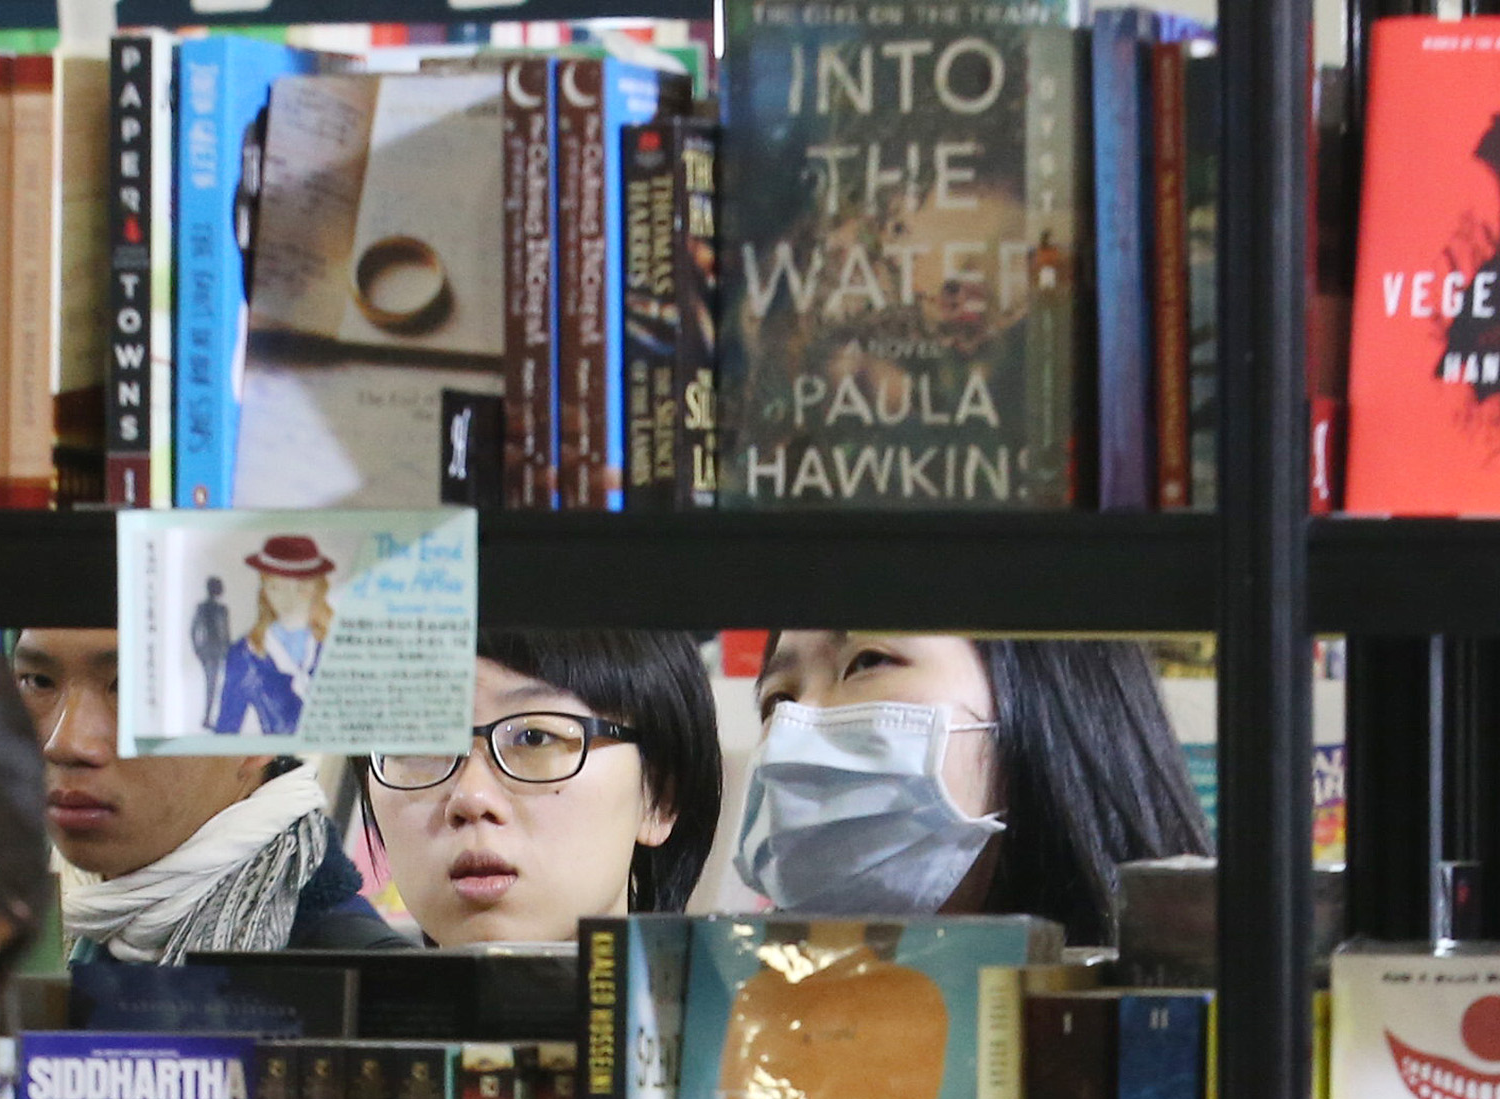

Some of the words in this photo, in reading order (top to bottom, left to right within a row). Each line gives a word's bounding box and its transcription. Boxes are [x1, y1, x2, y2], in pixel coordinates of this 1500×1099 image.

[753, 3, 793, 24] THE
[800, 3, 858, 25] GIRL
[867, 3, 903, 25] ON
[916, 4, 958, 25] THE
[788, 37, 1003, 115] INTO
[119, 45, 143, 214] PAPER
[806, 144, 984, 216] THE
[114, 274, 144, 442] TOWNS
[792, 372, 999, 429] PAULA
